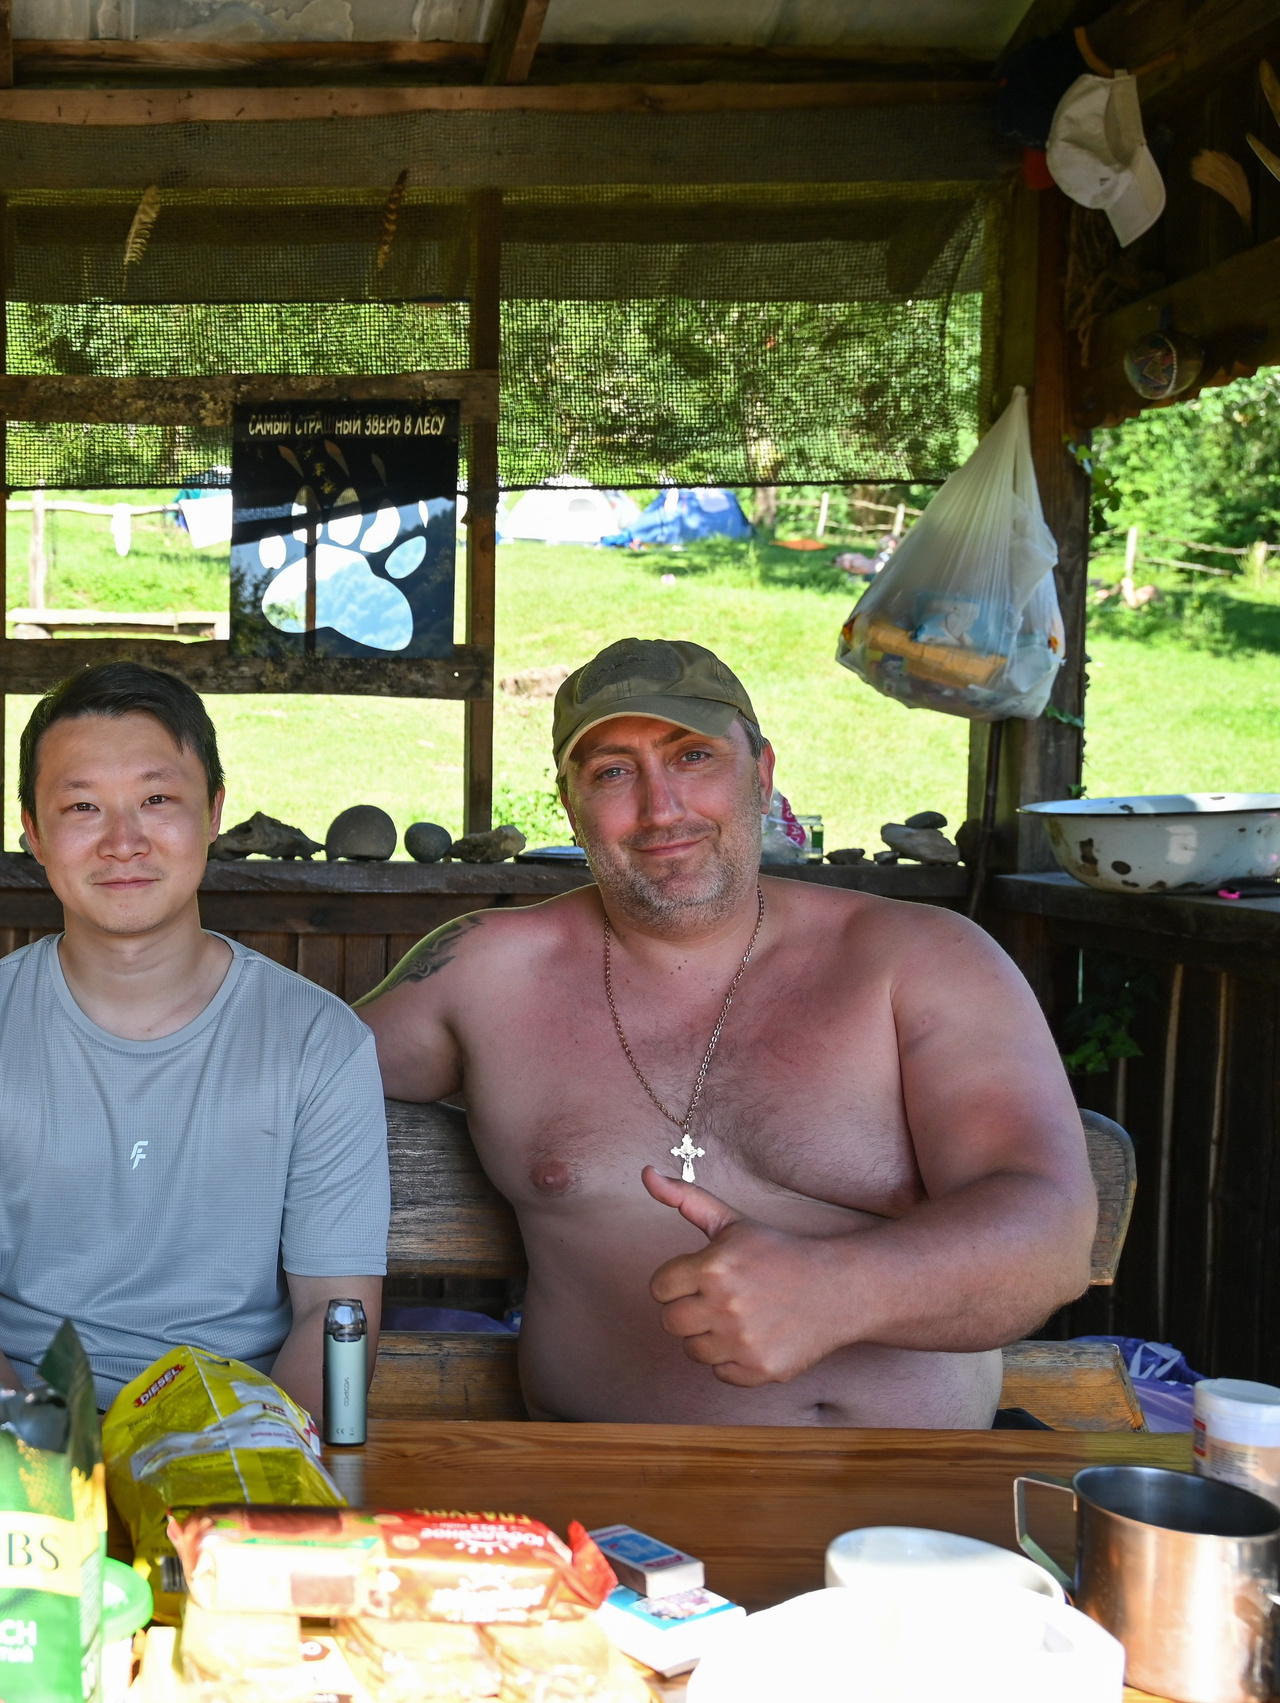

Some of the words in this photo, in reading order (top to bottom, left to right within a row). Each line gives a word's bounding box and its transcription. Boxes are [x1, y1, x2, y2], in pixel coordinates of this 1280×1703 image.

[248, 414, 292, 436] САМЫЙ
[295, 413, 362, 436] СТРАШНЫЙ
[364, 414, 401, 436] ЗВЕРЬ
[404, 416, 412, 435] В
[414, 414, 446, 436] ЛЕСУ
[140, 1368, 180, 1405] DIESEL
